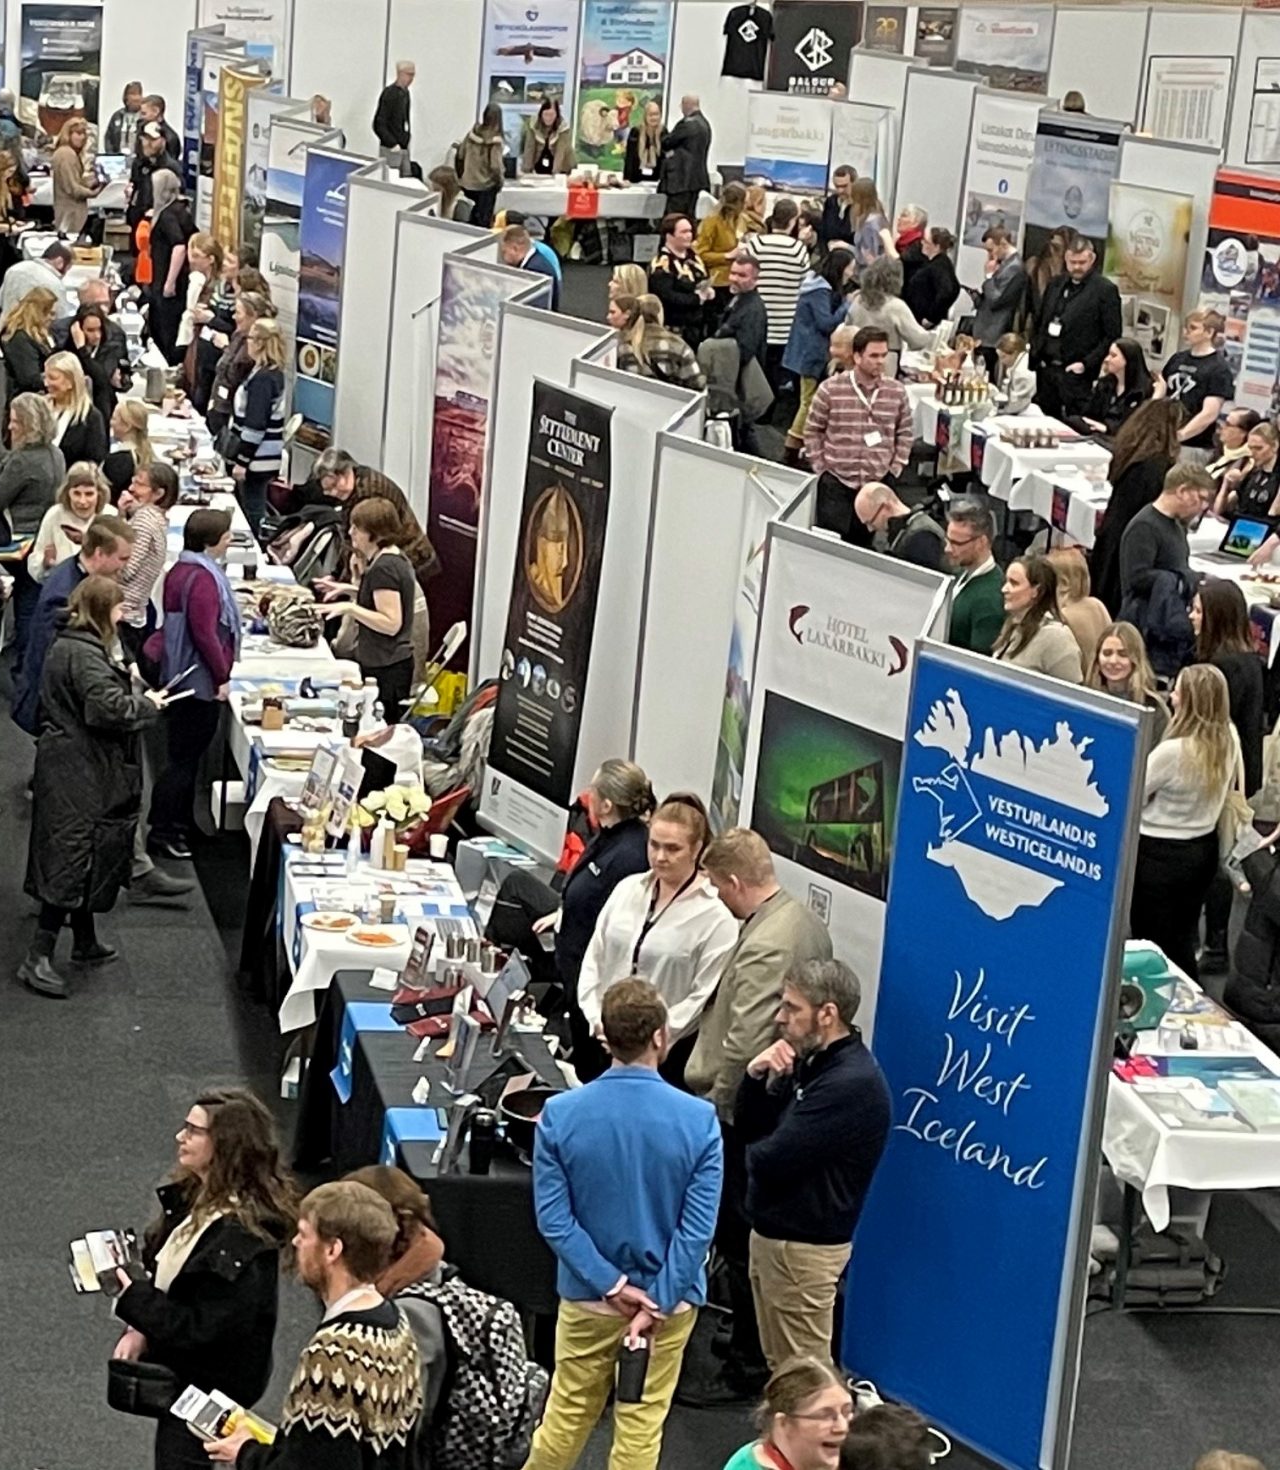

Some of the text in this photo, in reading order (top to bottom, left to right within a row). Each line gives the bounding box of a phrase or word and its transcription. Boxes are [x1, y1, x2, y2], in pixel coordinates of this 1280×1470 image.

[826, 615, 868, 644] HOTEL
[985, 822, 1102, 881] WESTICELAND.IS
[988, 794, 1097, 849] VESTURLAND.IS
[948, 967, 1036, 1048] Visit
[937, 1032, 1032, 1116] West
[893, 1087, 1049, 1189] Iceland
